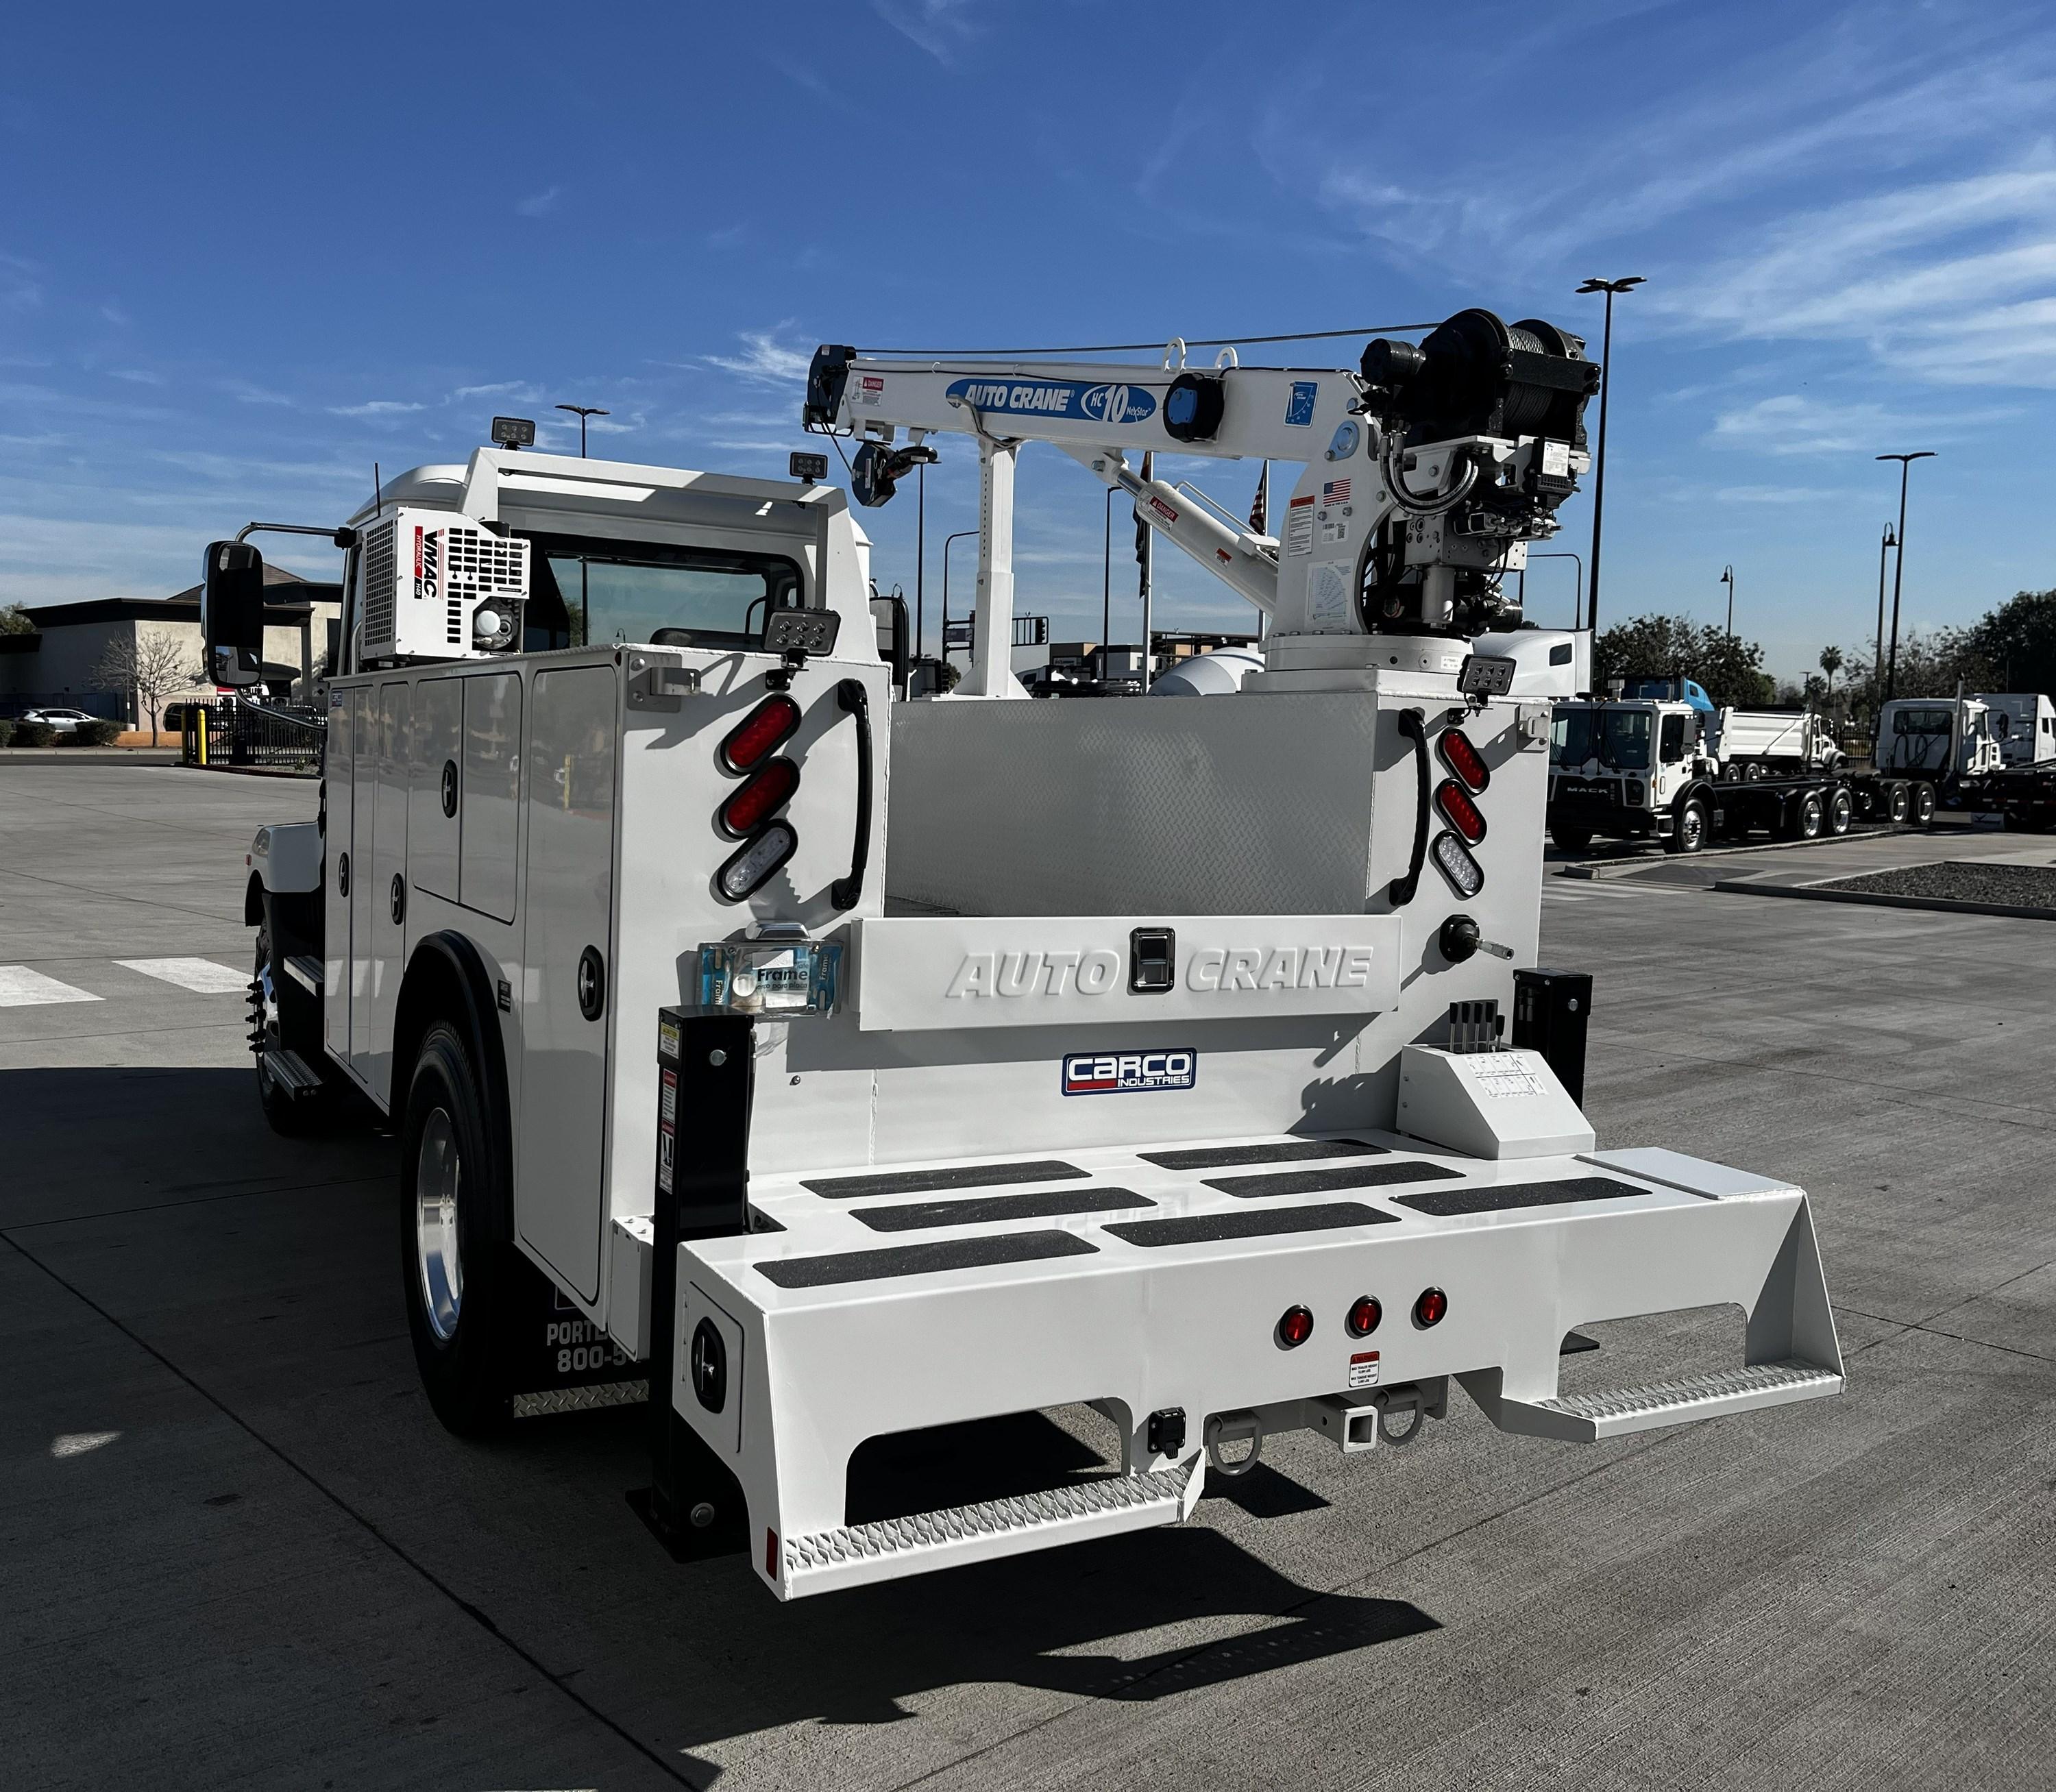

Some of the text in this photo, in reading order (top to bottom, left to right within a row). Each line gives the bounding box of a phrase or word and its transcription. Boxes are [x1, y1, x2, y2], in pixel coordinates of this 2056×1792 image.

[965, 384, 1070, 411] AUTO CRANE
[1090, 384, 1129, 424] HC 10
[1156, 502, 1176, 519] DANGER
[424, 530, 438, 598] VMAC
[757, 969, 808, 982] Frame
[819, 953, 829, 981] Frame
[945, 947, 1373, 998] AUTO CRANE
[714, 979, 723, 1005] Fram
[1117, 1075, 1190, 1088] INDUSTRIES
[547, 1320, 609, 1347] PORTL
[557, 1345, 628, 1372] 800-5
